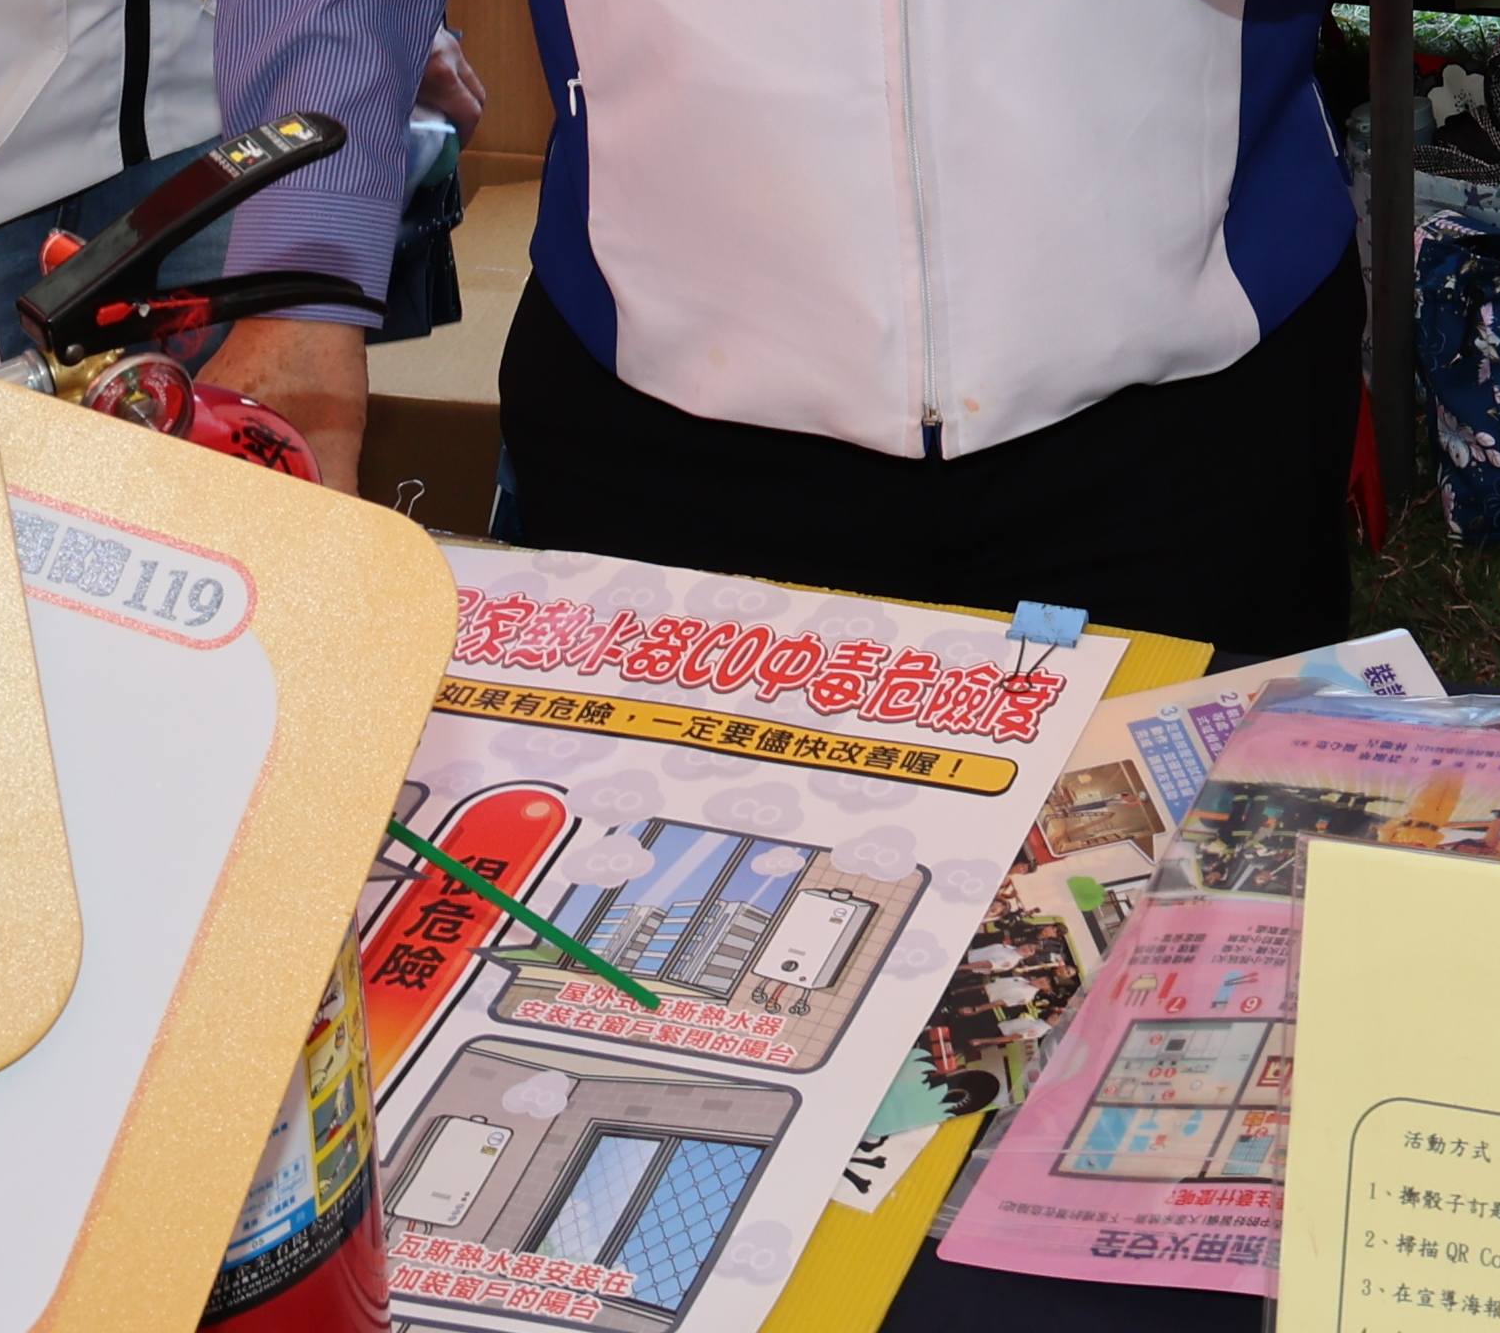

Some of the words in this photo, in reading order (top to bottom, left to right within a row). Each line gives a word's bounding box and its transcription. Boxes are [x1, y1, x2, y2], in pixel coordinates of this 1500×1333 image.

[514, 1000, 798, 1066] 安裝在窗戶緊閉的陽台
[389, 1233, 634, 1298] 瓦斯熱水器安裝在
[1445, 1241, 1469, 1264] QR
[388, 1264, 604, 1322] 加裝窗戶的陽台
